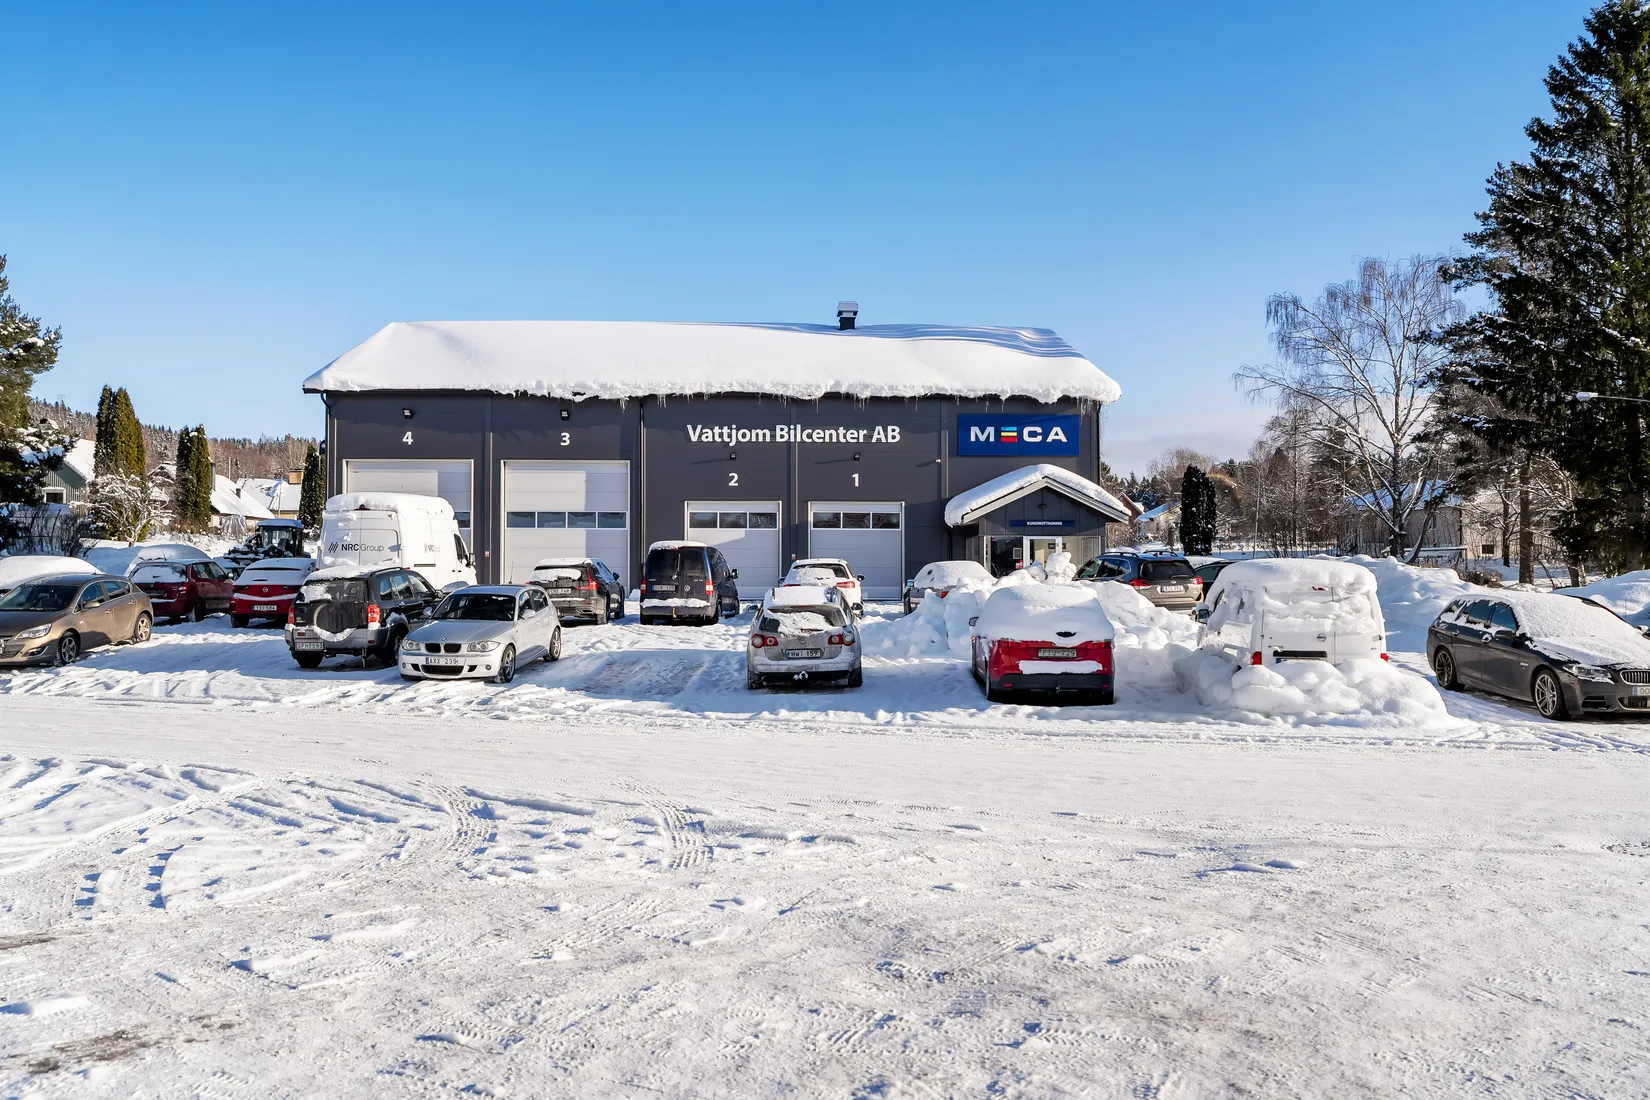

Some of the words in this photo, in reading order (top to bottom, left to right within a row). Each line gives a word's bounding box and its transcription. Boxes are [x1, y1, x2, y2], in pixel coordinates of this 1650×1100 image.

[402, 431, 414, 445] 4
[560, 432, 571, 446] 3
[686, 424, 771, 447] Vattjom
[775, 424, 867, 443] Bilcenter
[871, 425, 901, 443] AB
[728, 472, 739, 487] 2
[851, 473, 859, 487] 1
